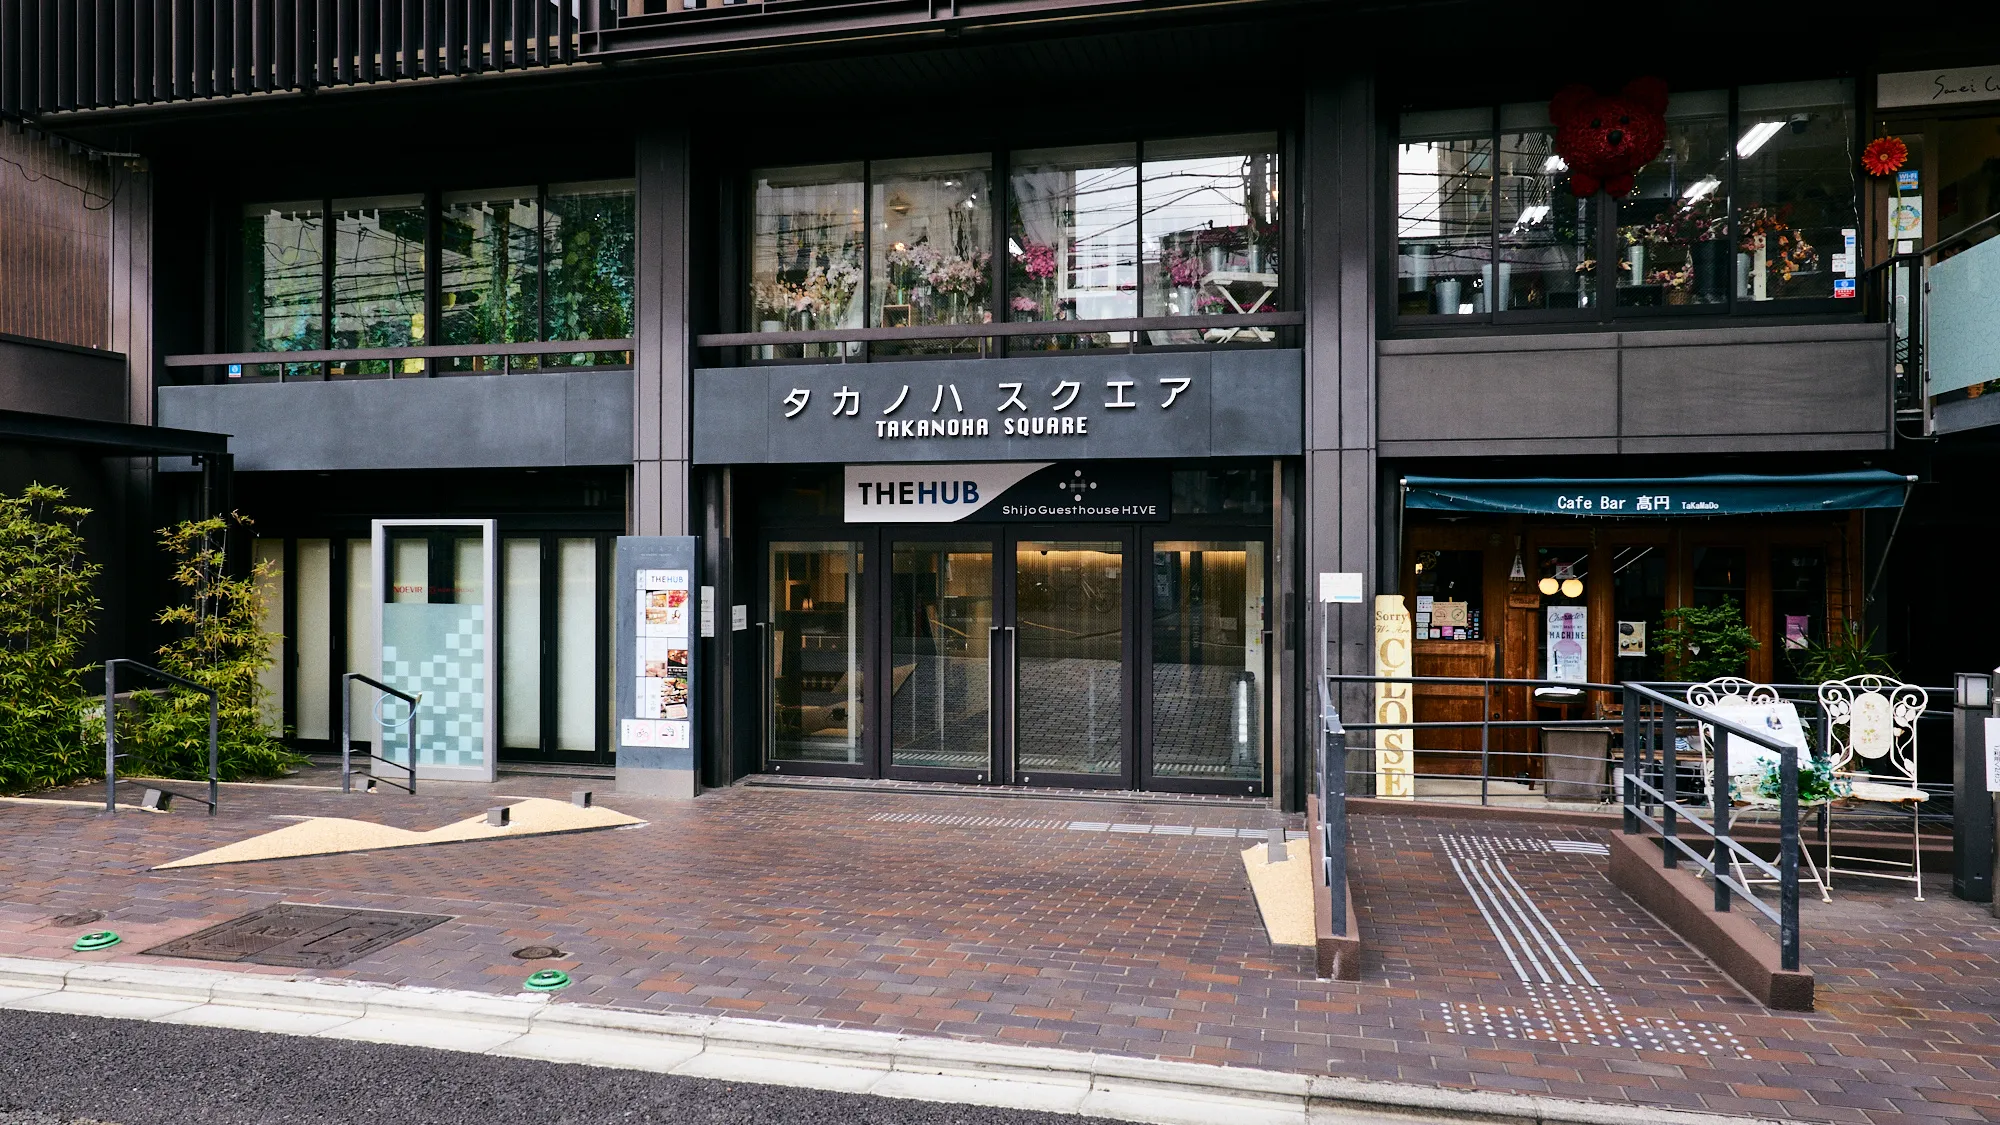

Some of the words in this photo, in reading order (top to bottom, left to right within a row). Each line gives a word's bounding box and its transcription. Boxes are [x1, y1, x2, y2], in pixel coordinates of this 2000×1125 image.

[875, 418, 989, 439] TAKANOHA
[1004, 415, 1088, 437] SQUARE
[1557, 495, 1592, 510] Cafe
[1600, 495, 1626, 510] Bar
[1002, 505, 1037, 517] Shijo
[1037, 505, 1120, 515] Guesthouse
[1122, 505, 1157, 515] HIVE
[393, 585, 423, 594] NOEVIR
[1376, 610, 1408, 624] Sorry
[1549, 631, 1585, 639] MACHINE
